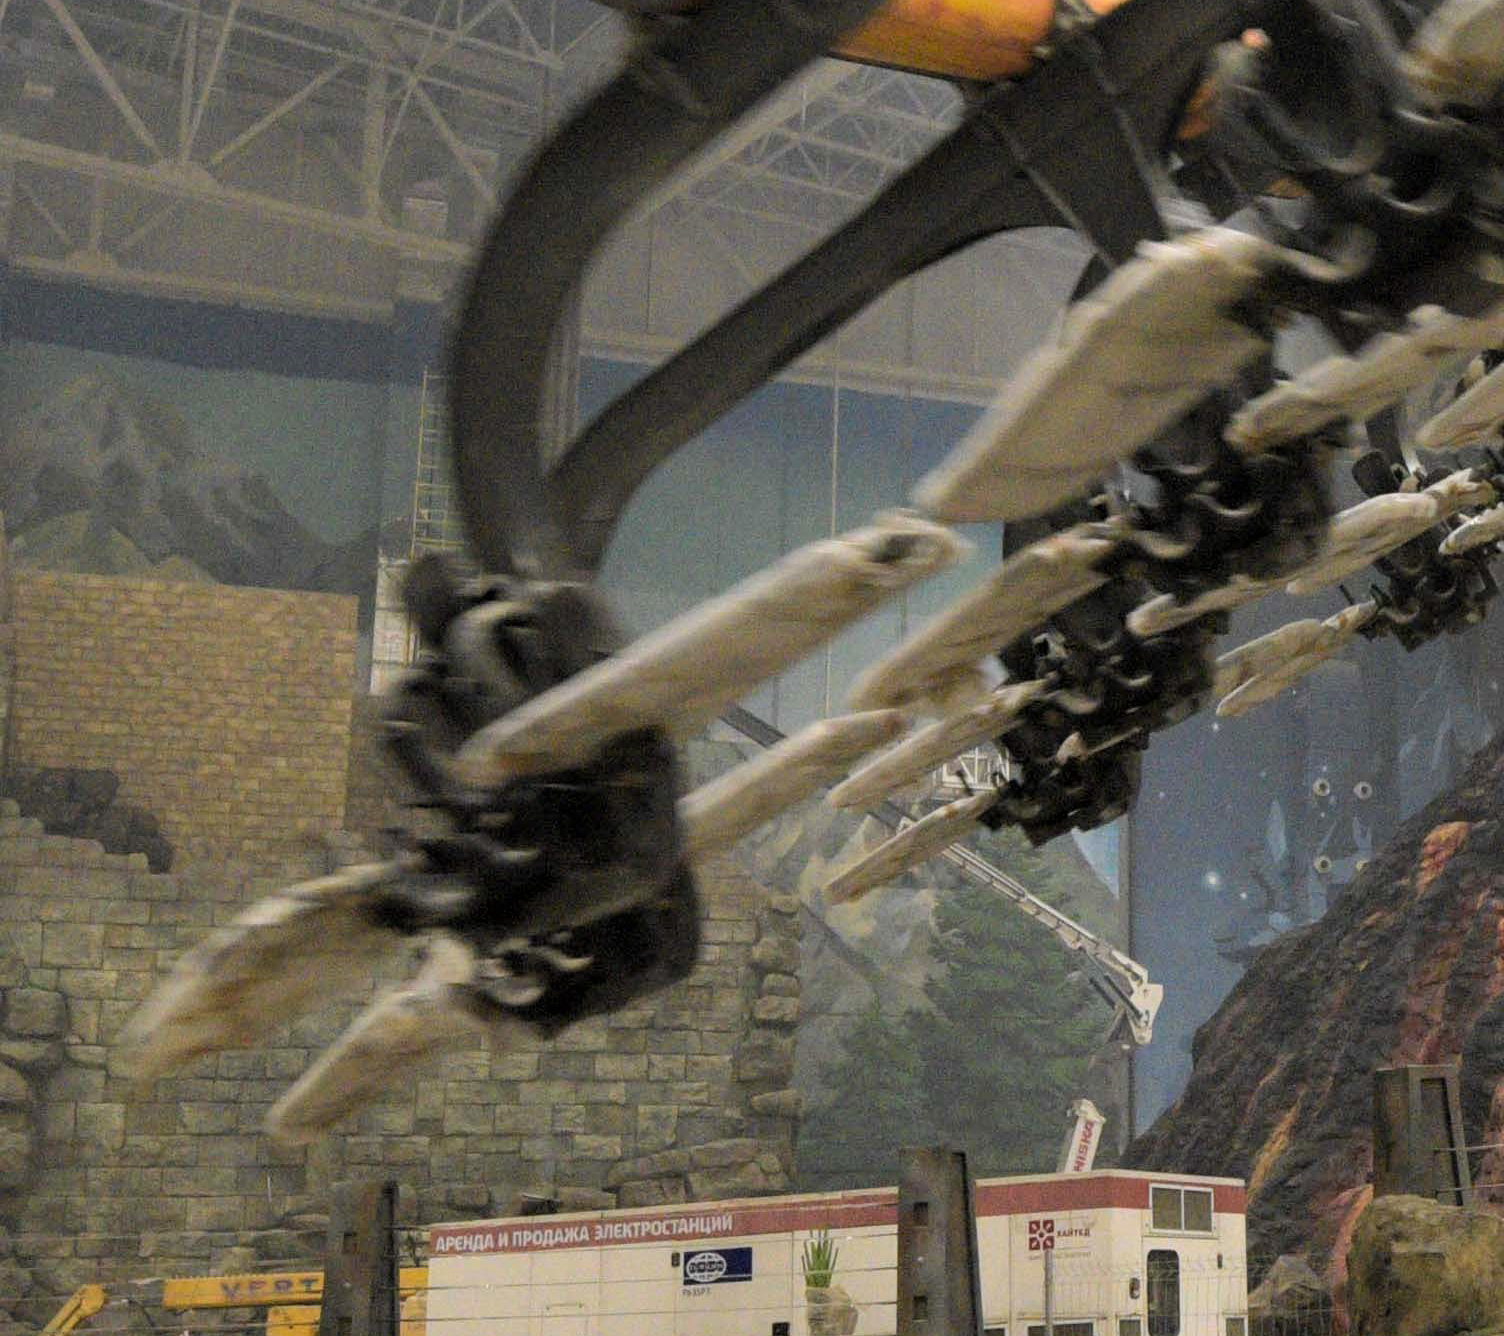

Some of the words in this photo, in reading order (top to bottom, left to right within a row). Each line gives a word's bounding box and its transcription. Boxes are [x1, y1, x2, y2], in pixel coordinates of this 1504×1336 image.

[435, 1233, 494, 1253] АРЕНДА
[497, 1233, 509, 1247] И
[512, 1225, 590, 1247] ПРОДАЖА
[595, 1214, 734, 1241] ЭЛЕКТРОСТАНЦИЙ
